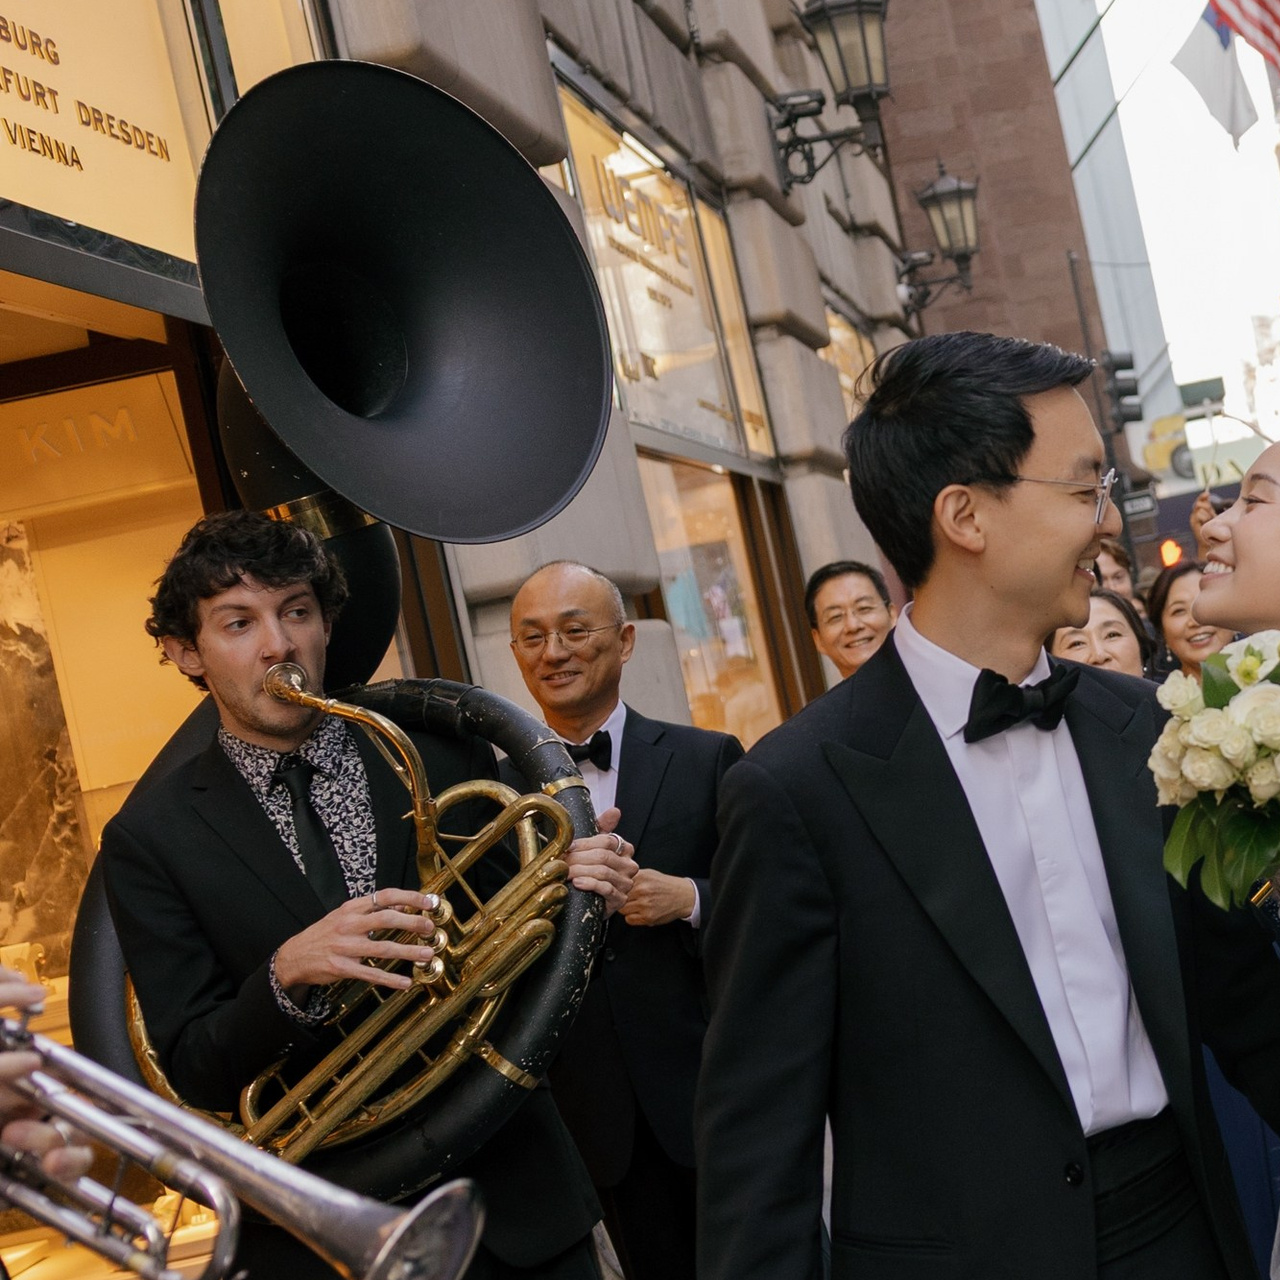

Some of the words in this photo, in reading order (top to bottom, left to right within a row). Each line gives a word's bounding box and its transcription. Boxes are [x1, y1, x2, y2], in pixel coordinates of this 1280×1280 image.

[0, 65, 59, 114] FURT
[74, 99, 171, 162] DRESDEN
[2, 117, 84, 172] VIENNA
[591, 153, 690, 268] WEMPE
